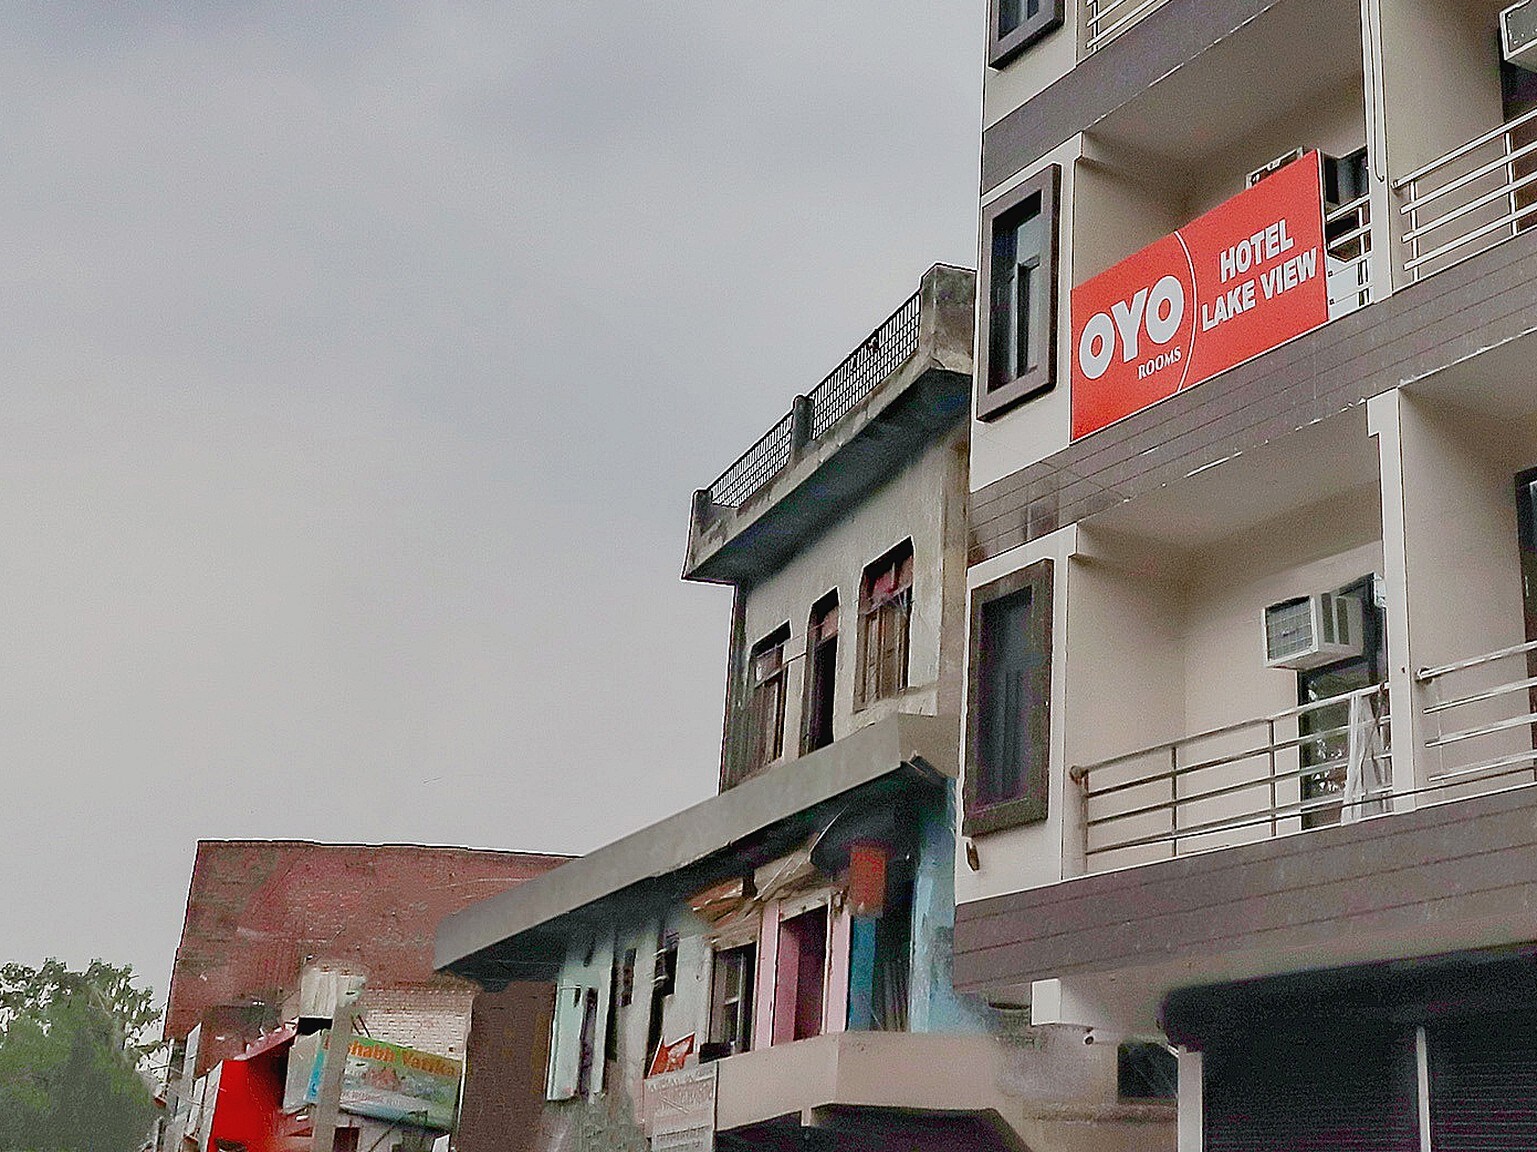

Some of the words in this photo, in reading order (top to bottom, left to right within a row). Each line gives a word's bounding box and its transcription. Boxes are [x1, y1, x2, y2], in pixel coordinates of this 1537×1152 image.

[1201, 279, 1256, 332] LAKE
[1260, 246, 1317, 300] VIEW
[1220, 218, 1294, 284] HOTEL
[1079, 275, 1184, 380] OYO
[1137, 346, 1182, 380] ROOMS
